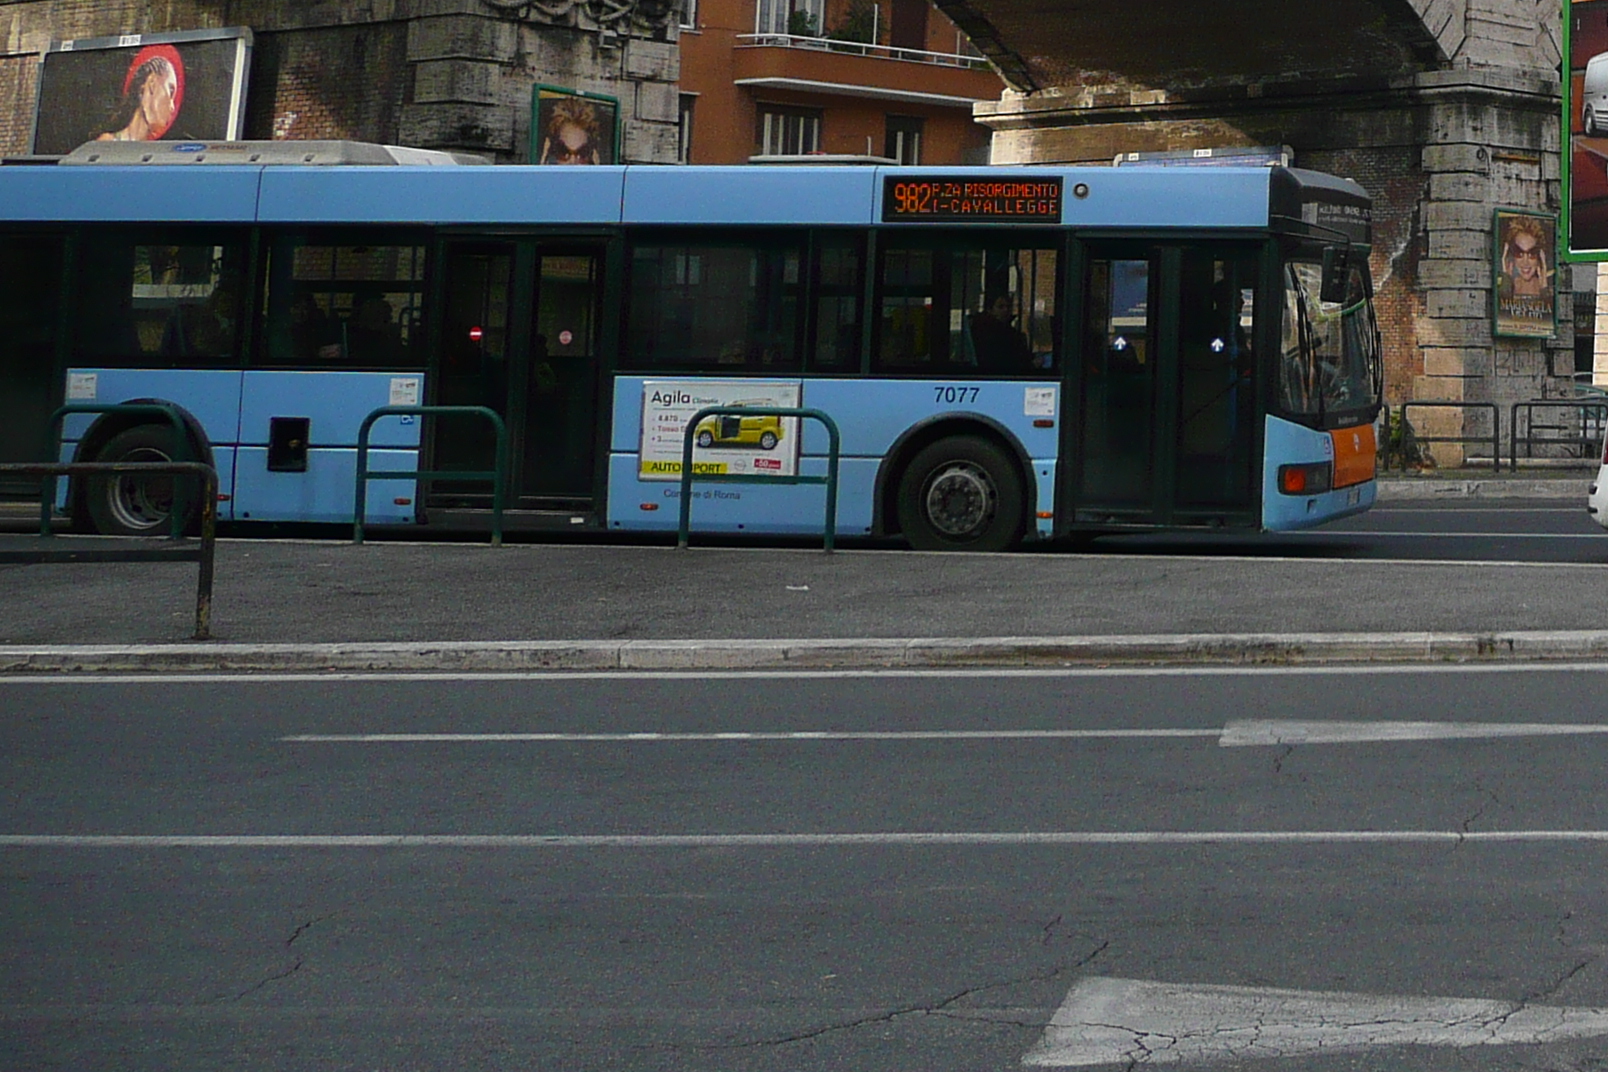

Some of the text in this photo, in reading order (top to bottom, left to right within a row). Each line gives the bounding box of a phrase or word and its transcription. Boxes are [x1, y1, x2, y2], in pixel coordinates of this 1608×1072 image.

[894, 183, 1058, 213] 982 P.ZA RISORGIMENTO
[651, 390, 691, 407] Agila
[934, 386, 980, 404] 7077
[651, 462, 721, 474] AUTOPORT
[663, 488, 741, 500] Cone di Roma
